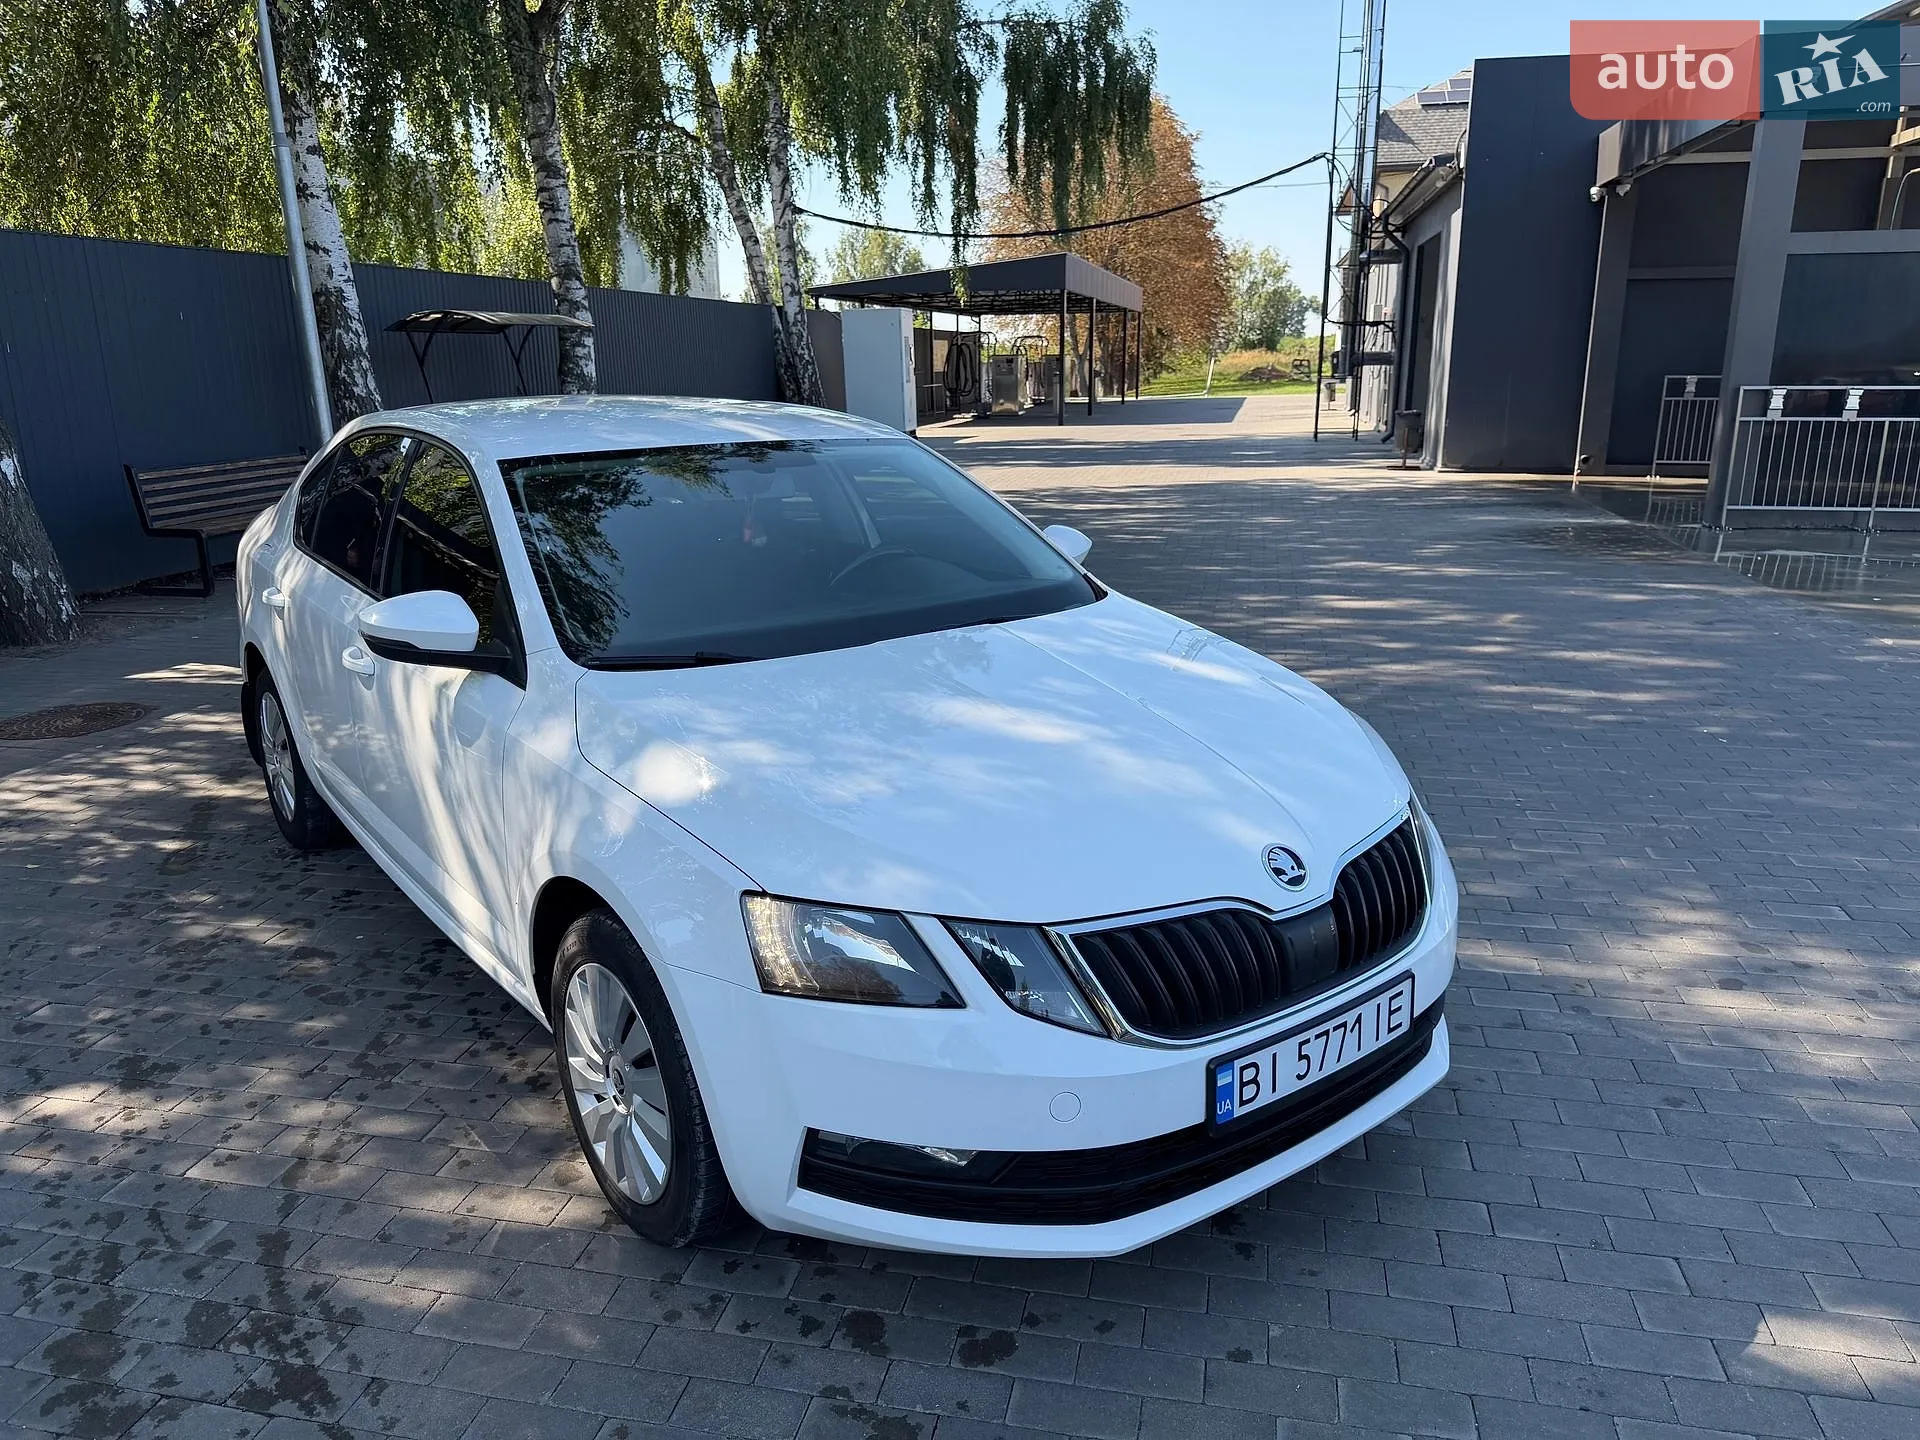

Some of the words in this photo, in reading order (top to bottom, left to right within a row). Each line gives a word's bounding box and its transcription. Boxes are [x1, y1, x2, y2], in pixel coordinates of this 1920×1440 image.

[1239, 1052, 1277, 1108] BI
[1296, 1012, 1362, 1081] 5771
[1375, 989, 1404, 1042] IE
[1216, 1099, 1232, 1115] UA
